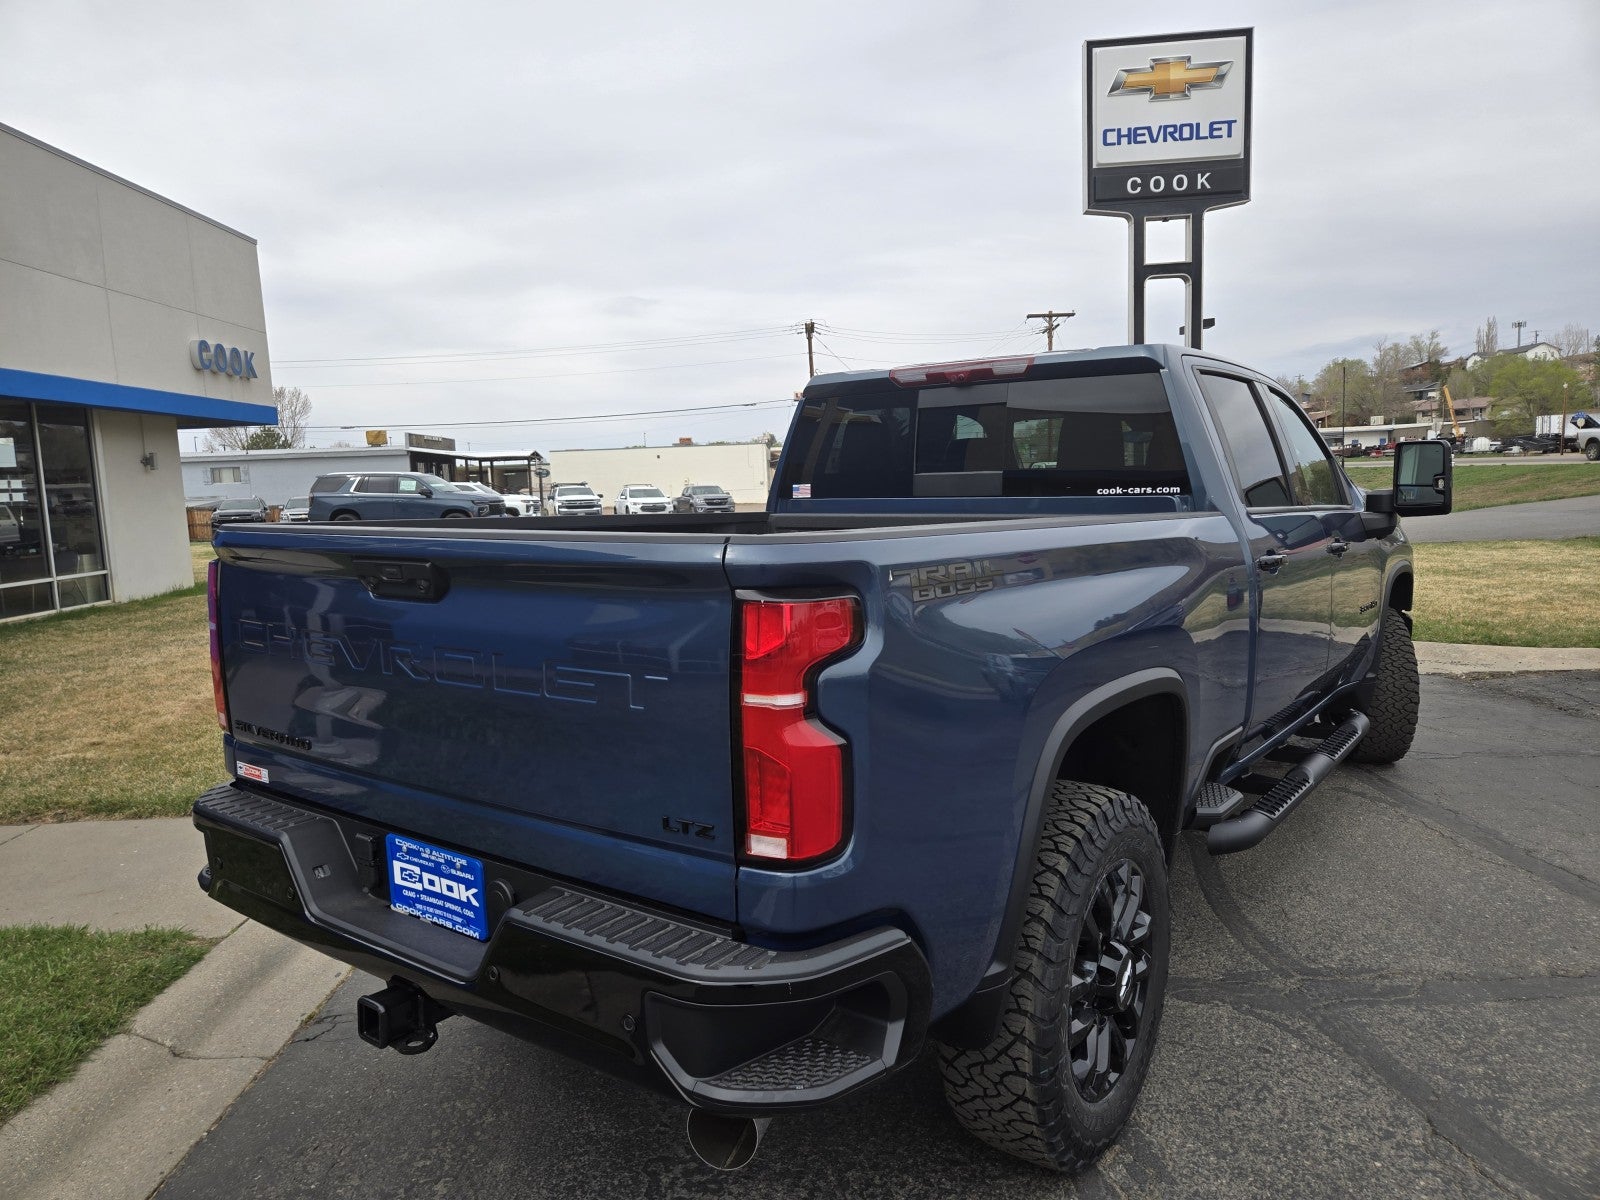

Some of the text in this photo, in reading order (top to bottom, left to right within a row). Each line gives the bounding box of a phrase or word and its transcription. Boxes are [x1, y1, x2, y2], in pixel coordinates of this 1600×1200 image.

[1102, 119, 1237, 147] CHEVROLET
[1126, 172, 1212, 194] COOK
[197, 339, 258, 379] COOK
[1096, 486, 1180, 495] cook-cars.com
[891, 560, 1004, 588] TRAIL
[912, 577, 993, 602] BOSS
[236, 617, 669, 711] CHEVROLET
[662, 815, 715, 840] LTZ
[432, 850, 467, 866] ALTITUDE
[392, 860, 480, 907] COOK
[450, 868, 474, 881] SUBARU
[420, 894, 444, 907] STEAMBOAT
[396, 902, 480, 940] COOK-CARS.COM
